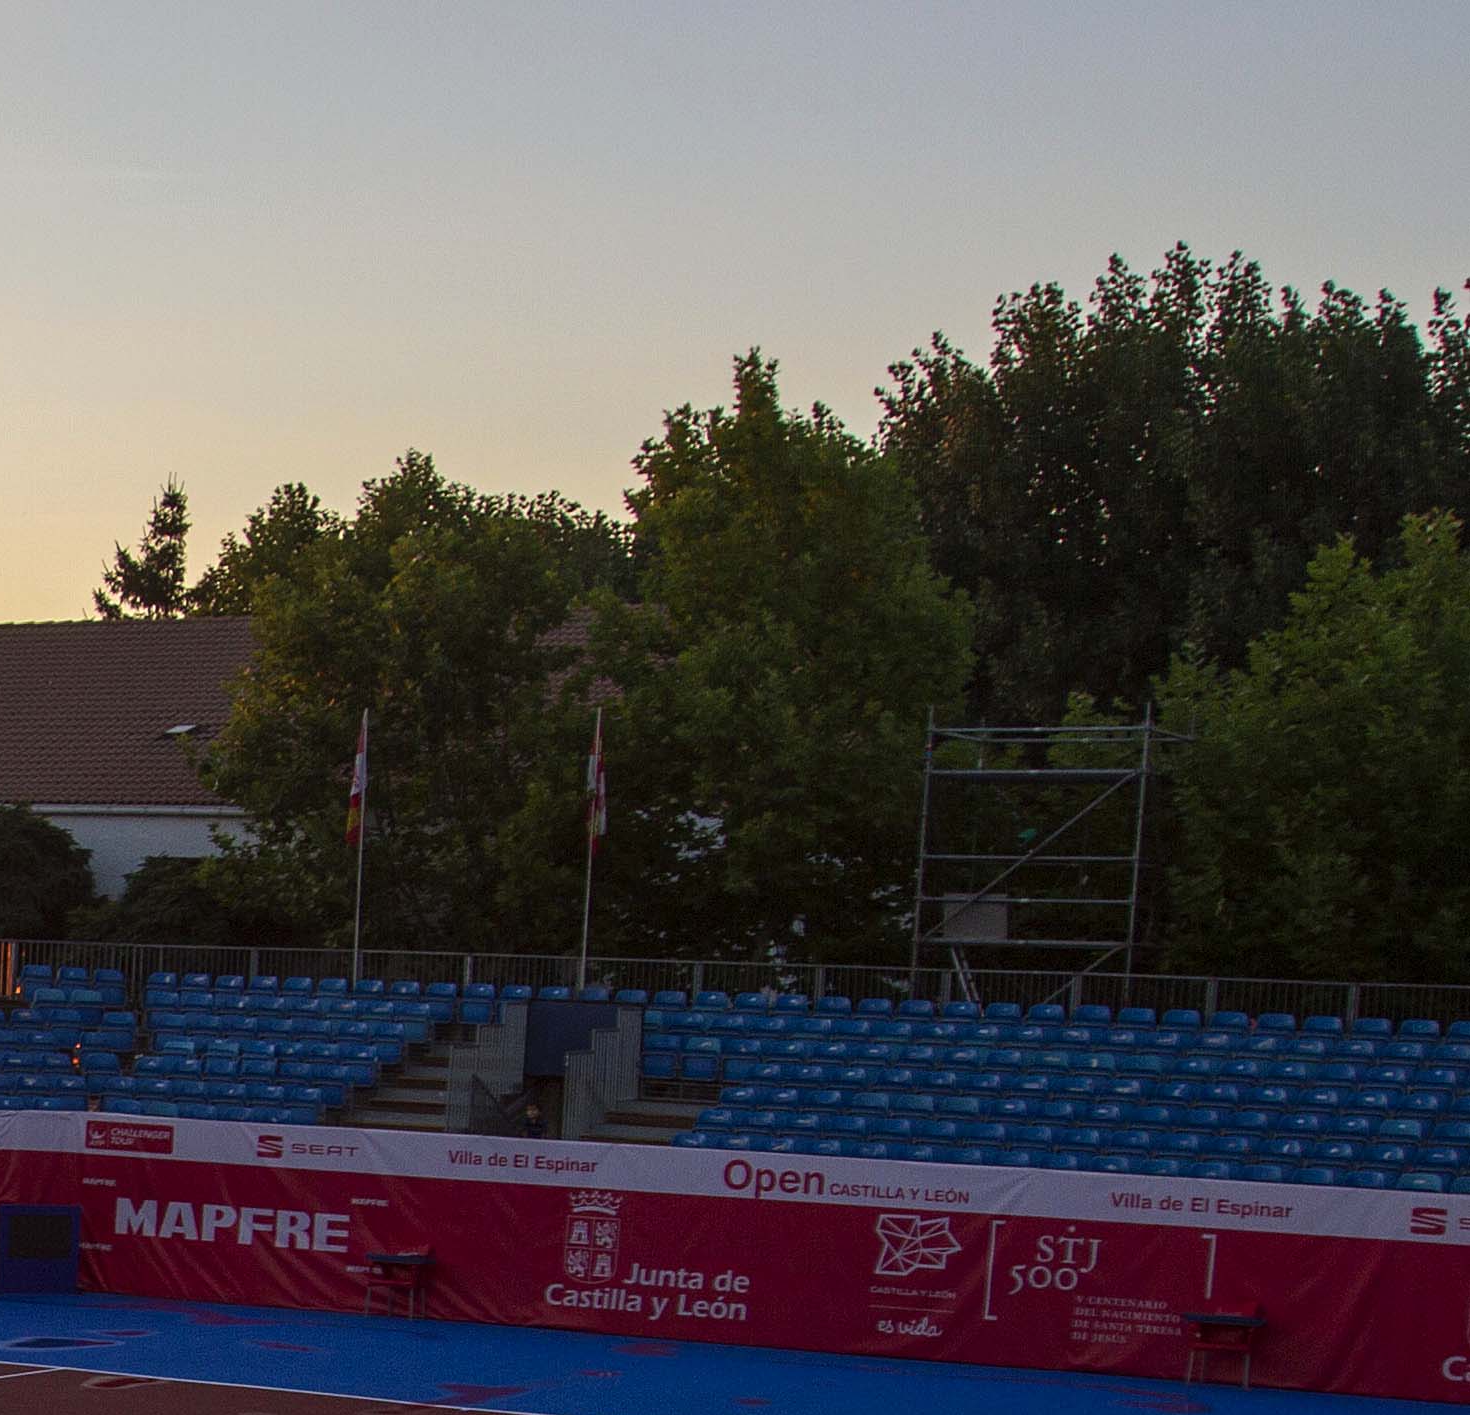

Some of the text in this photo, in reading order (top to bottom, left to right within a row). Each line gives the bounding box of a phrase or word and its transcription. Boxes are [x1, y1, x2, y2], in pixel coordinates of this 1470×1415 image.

[291, 1143, 360, 1157] SEAT
[448, 1149, 599, 1174] Villa de El Espinar
[723, 1158, 970, 1204] Open CASTILLA Y LEÓN
[1111, 1191, 1293, 1219] Villa de El Espinar
[114, 1197, 351, 1254] MAPFRE
[622, 1262, 750, 1293] Junta de
[1008, 1264, 1078, 1296] 500
[545, 1283, 747, 1321] Castilla y León
[1088, 1295, 1168, 1309] CENTENARIO
[877, 1316, 944, 1337] es vida
[1101, 1309, 1180, 1324] NACIMIENTO
